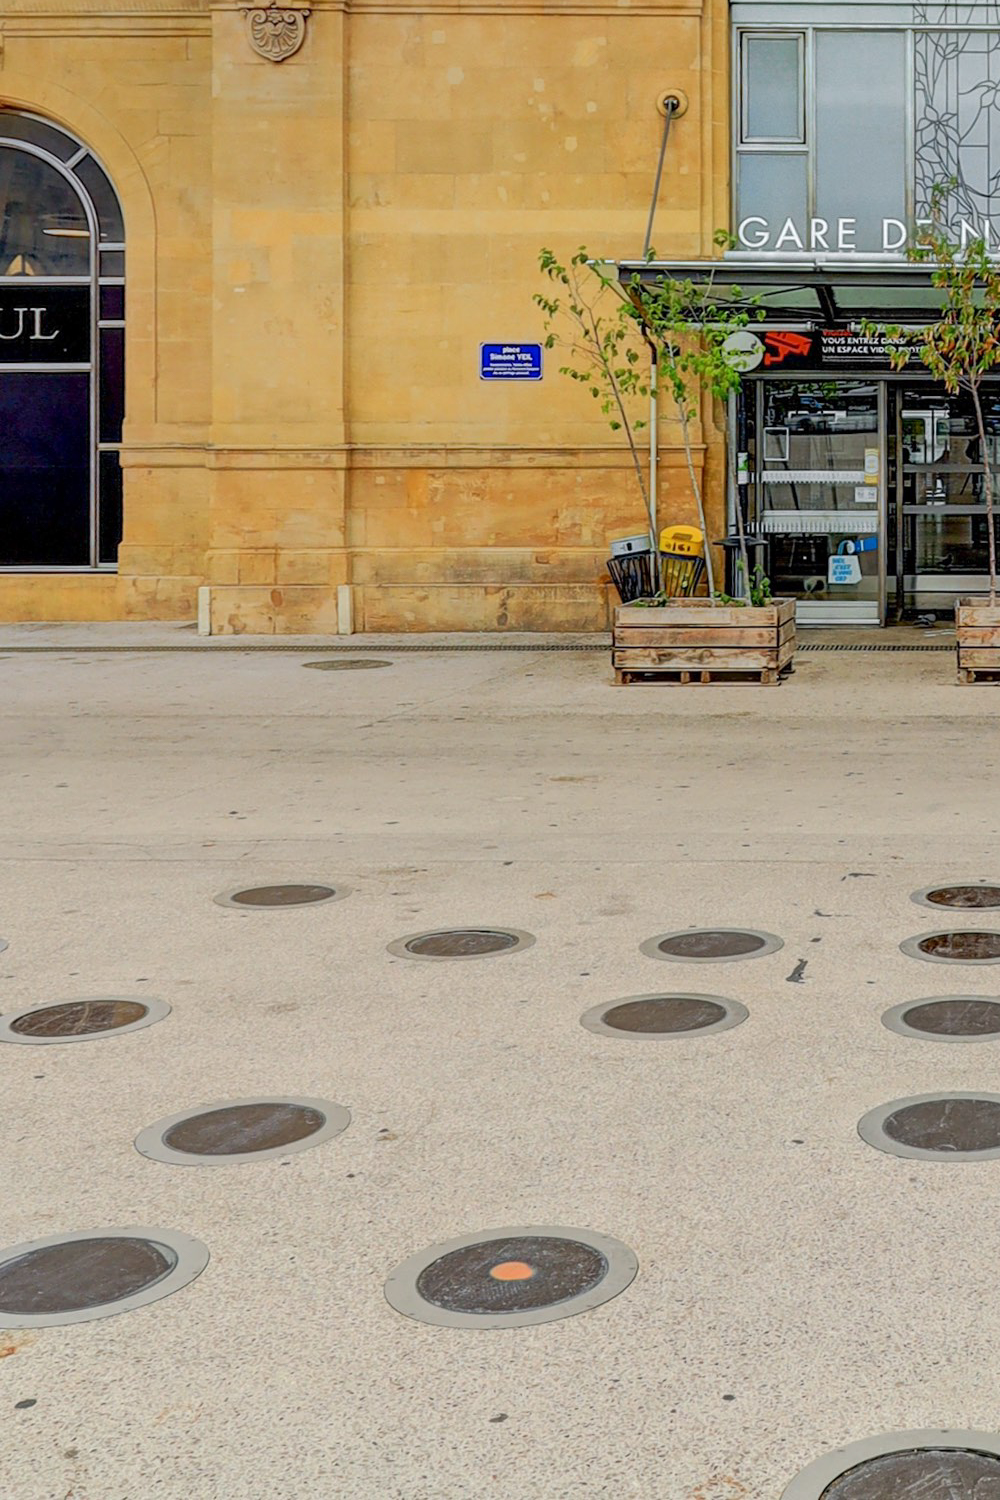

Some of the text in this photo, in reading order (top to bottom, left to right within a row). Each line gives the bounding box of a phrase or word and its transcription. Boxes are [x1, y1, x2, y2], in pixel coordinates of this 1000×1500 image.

[738, 216, 857, 249] GARE
[882, 217, 934, 250] DE
[848, 337, 880, 345] ENTREZ
[821, 346, 835, 354] UN
[837, 346, 869, 354] ESPACE
